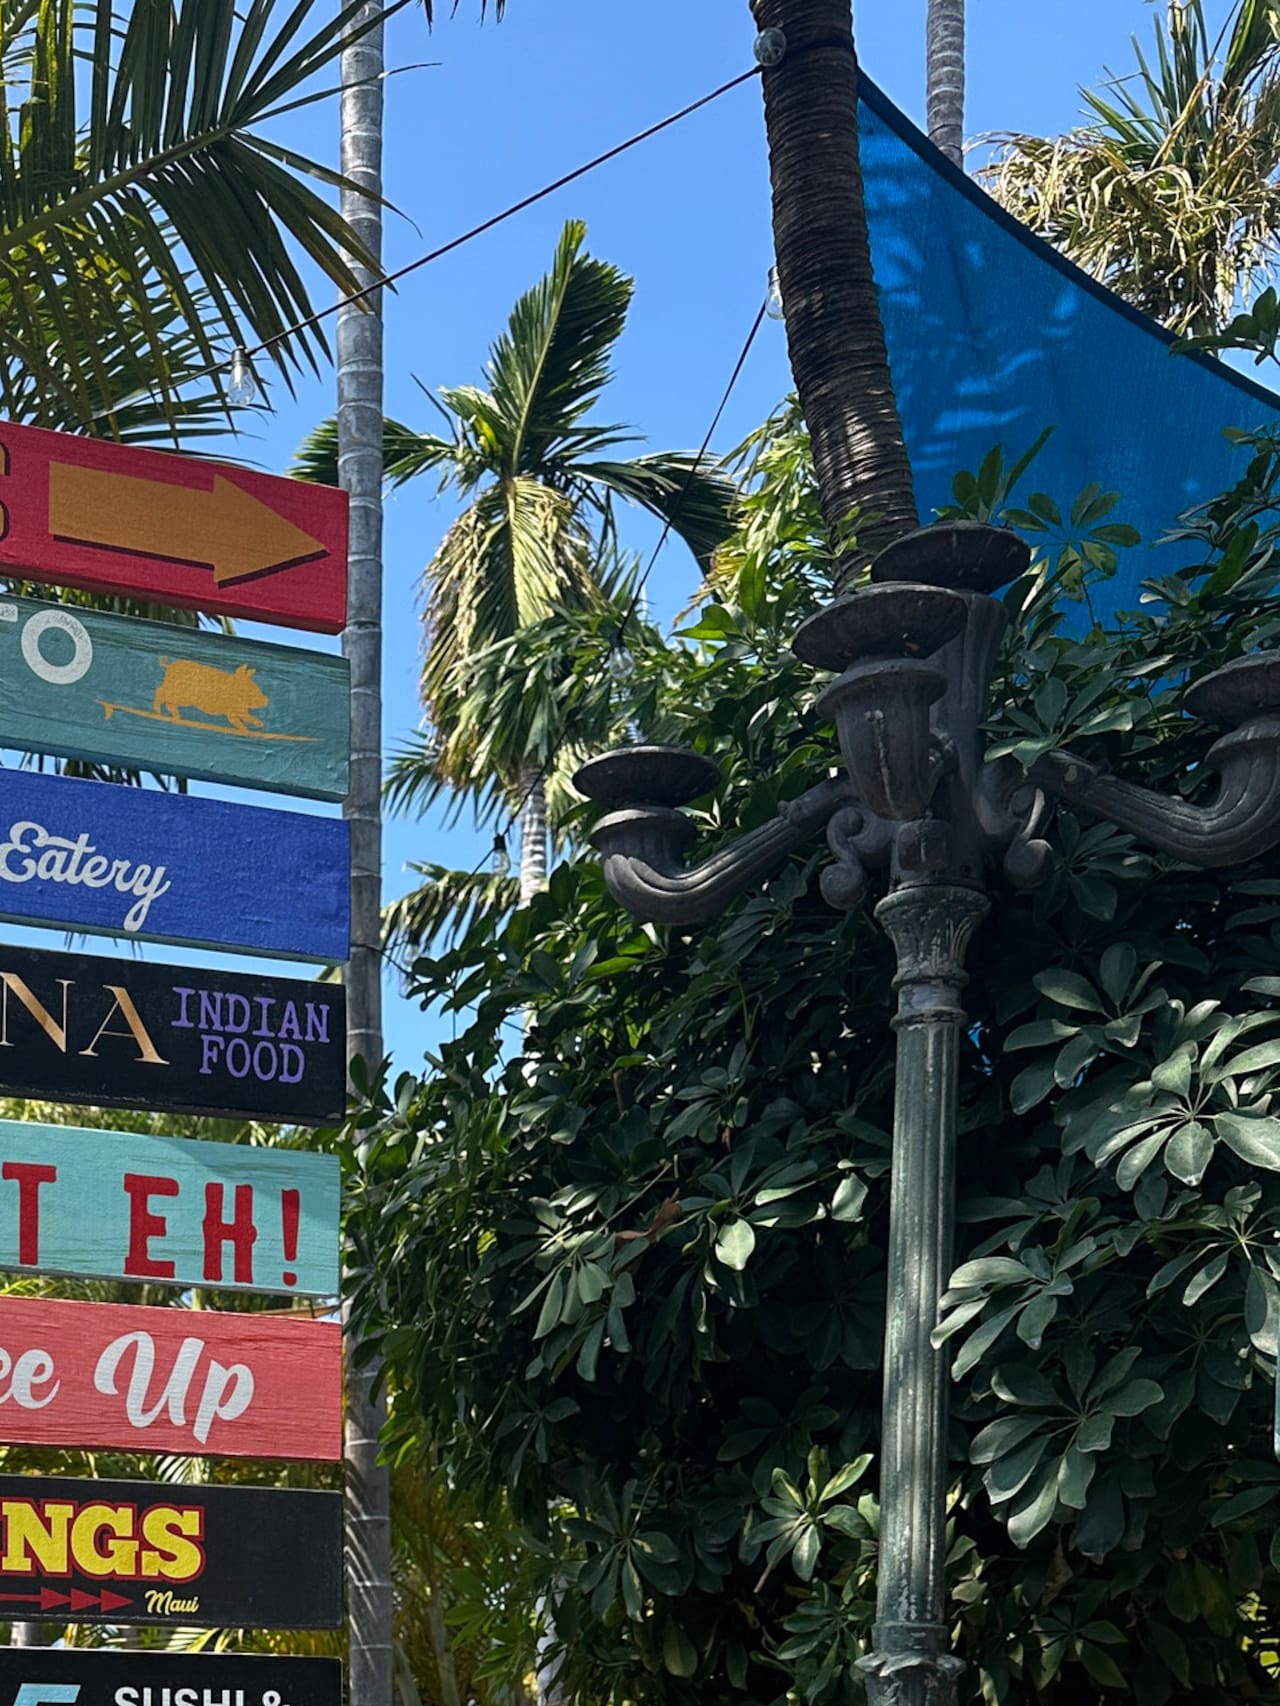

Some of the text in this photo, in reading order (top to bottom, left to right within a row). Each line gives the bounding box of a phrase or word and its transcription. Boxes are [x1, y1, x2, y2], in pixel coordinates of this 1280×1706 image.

[171, 985, 331, 1045] INDIAN
[200, 1035, 306, 1085] FOOD
[122, 1173, 301, 1287] EH!
[93, 1327, 254, 1444] Up
[144, 1589, 200, 1616] Maui
